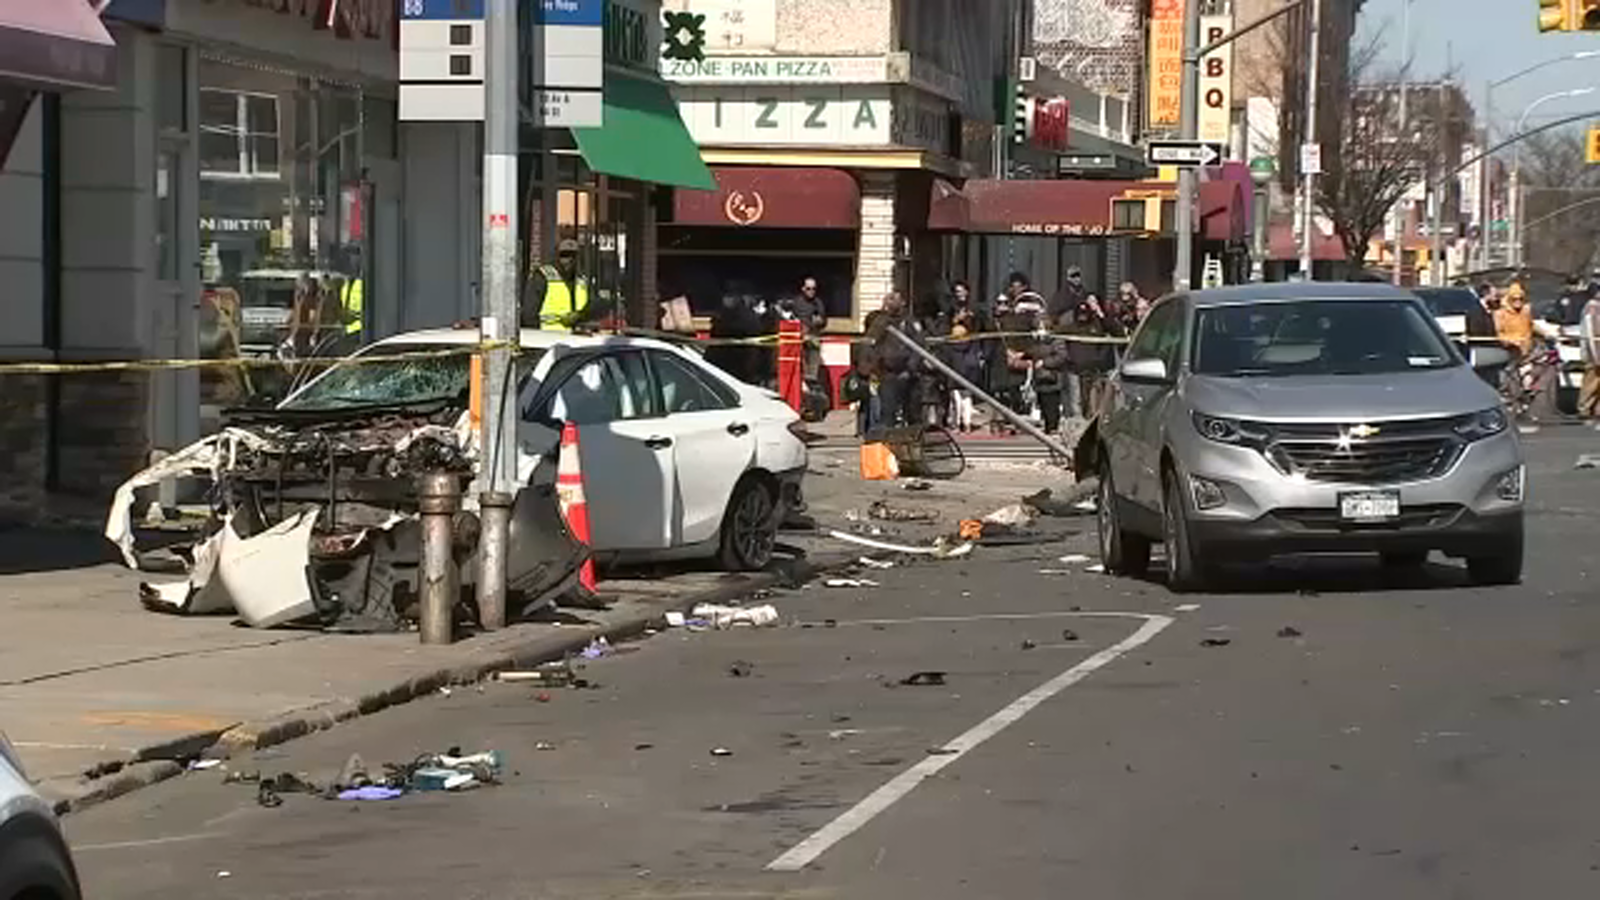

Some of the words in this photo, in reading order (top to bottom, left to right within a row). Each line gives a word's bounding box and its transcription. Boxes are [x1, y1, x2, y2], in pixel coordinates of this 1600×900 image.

[731, 61, 768, 76] PAN
[777, 61, 831, 76] PIZZA
[1012, 224, 1042, 233] HOME
[1045, 224, 1059, 233] OF
[1062, 224, 1082, 235] THE
